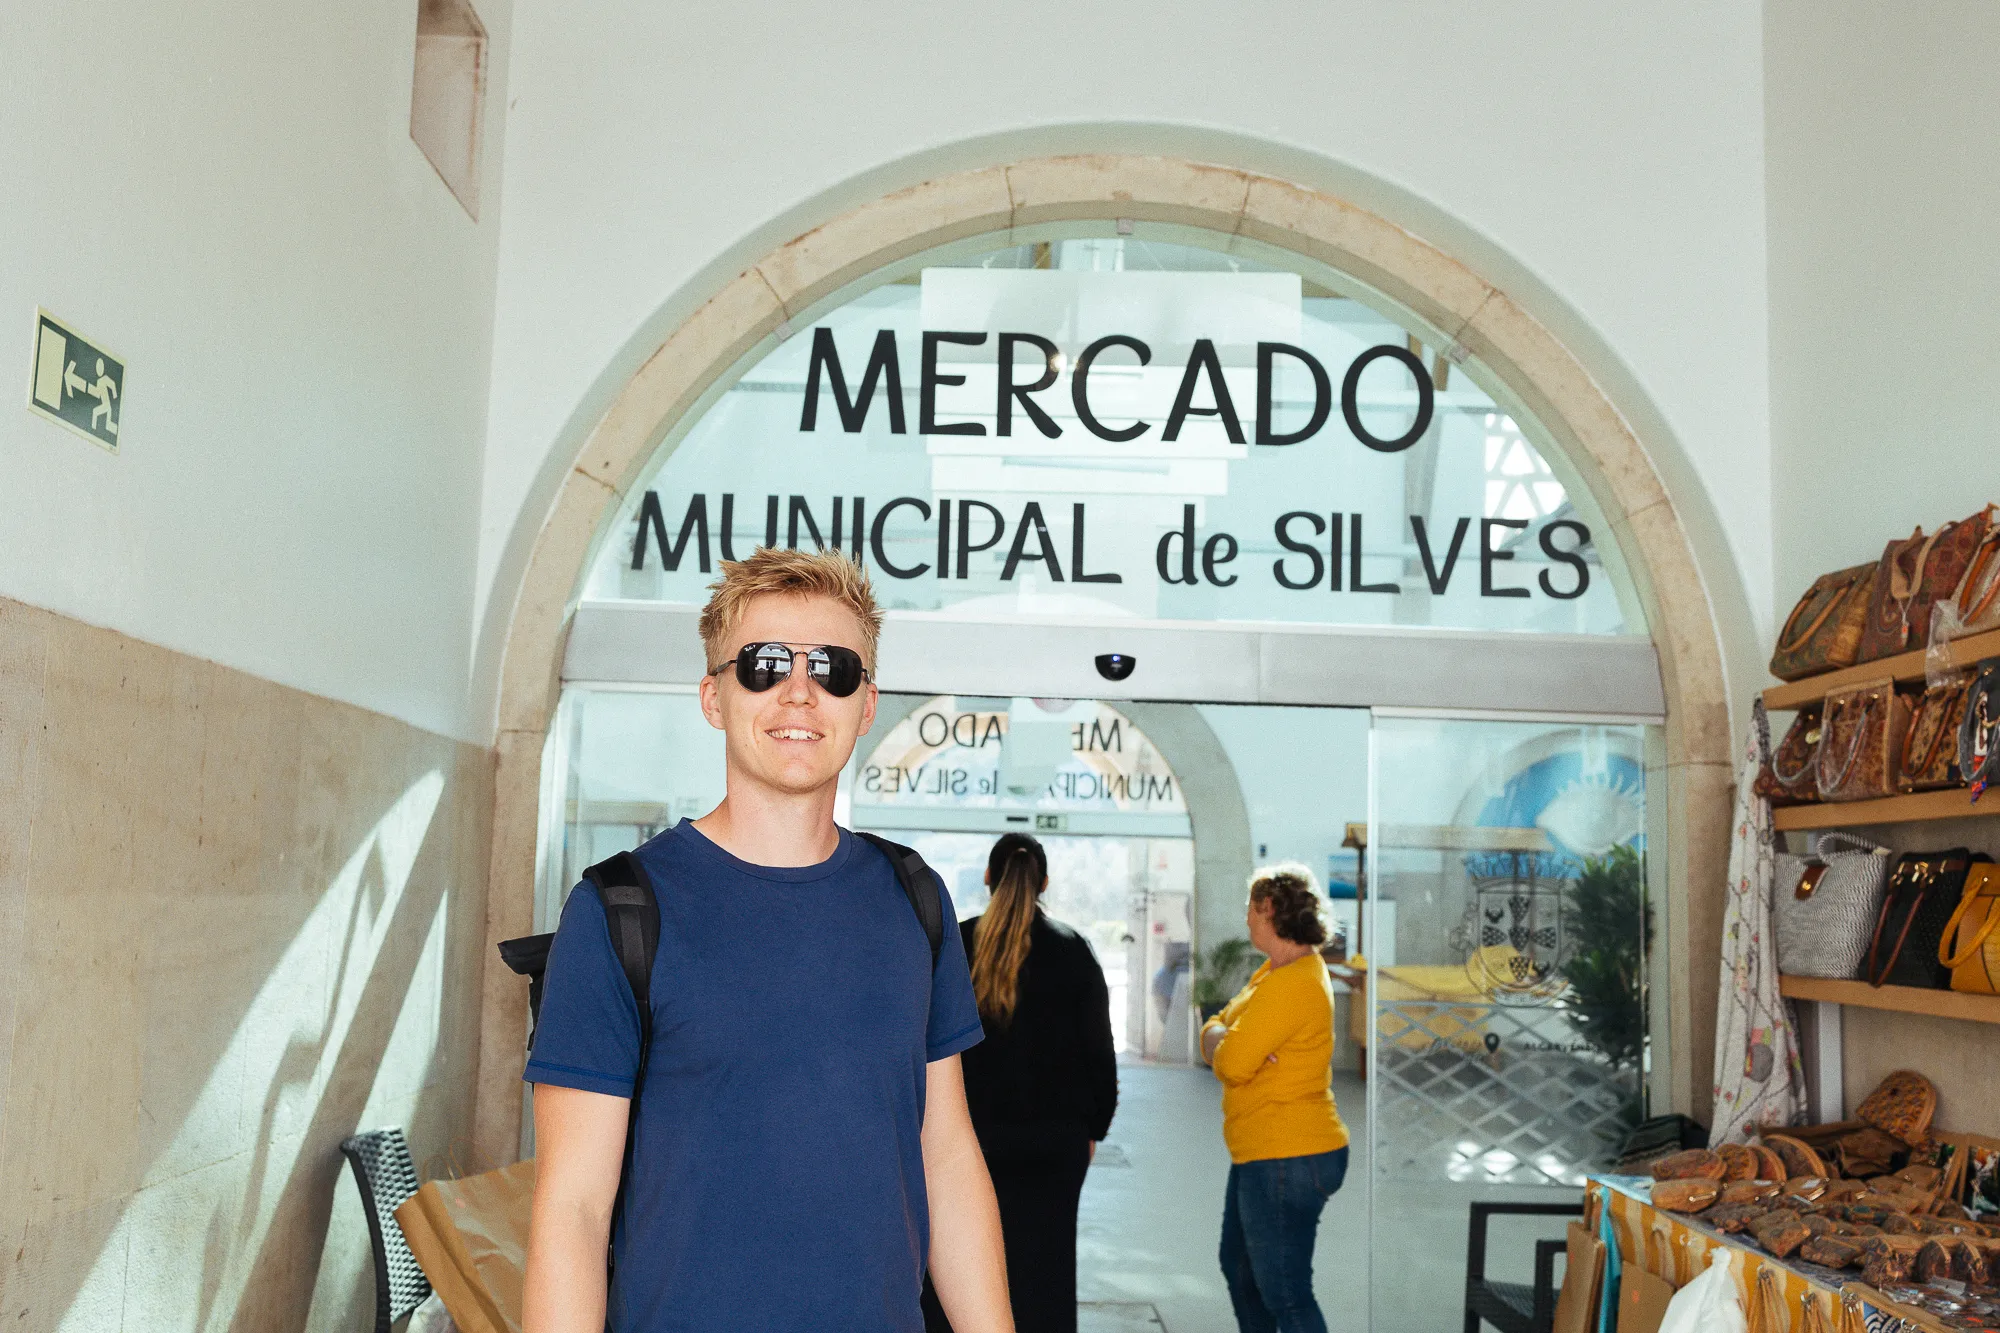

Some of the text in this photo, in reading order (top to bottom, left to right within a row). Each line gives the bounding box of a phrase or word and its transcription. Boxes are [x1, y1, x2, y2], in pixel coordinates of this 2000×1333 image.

[800, 327, 1434, 452] MERCADO
[631, 491, 1592, 600] MUNICIPAL de SILVES
